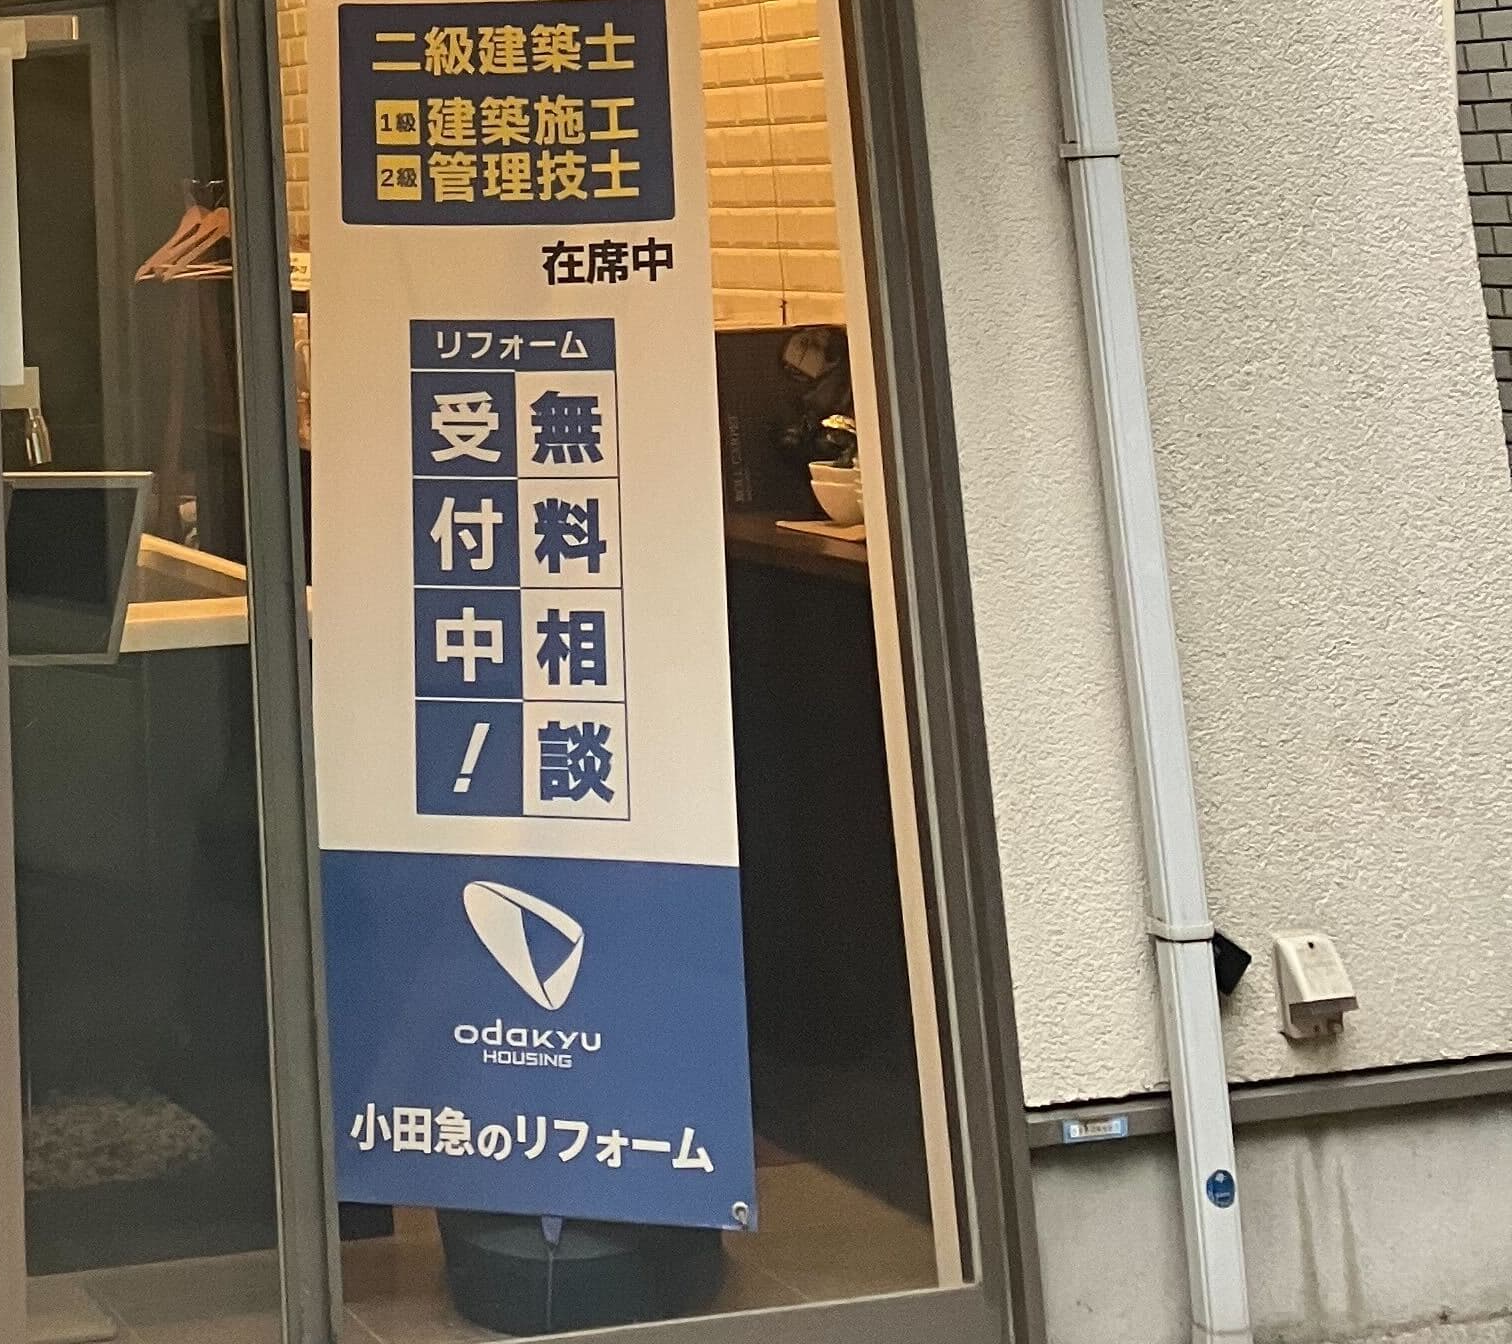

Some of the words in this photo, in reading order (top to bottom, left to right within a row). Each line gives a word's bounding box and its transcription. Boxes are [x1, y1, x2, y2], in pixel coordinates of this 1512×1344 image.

[372, 23, 635, 76] 二級建築士
[541, 237, 674, 286] 在席中
[435, 330, 589, 360] リフォーム
[530, 389, 616, 804] 無料相談
[453, 1018, 602, 1052] odakyu
[482, 1049, 573, 1069] HOUSING
[350, 1103, 714, 1173] 小田急のリフォーム
